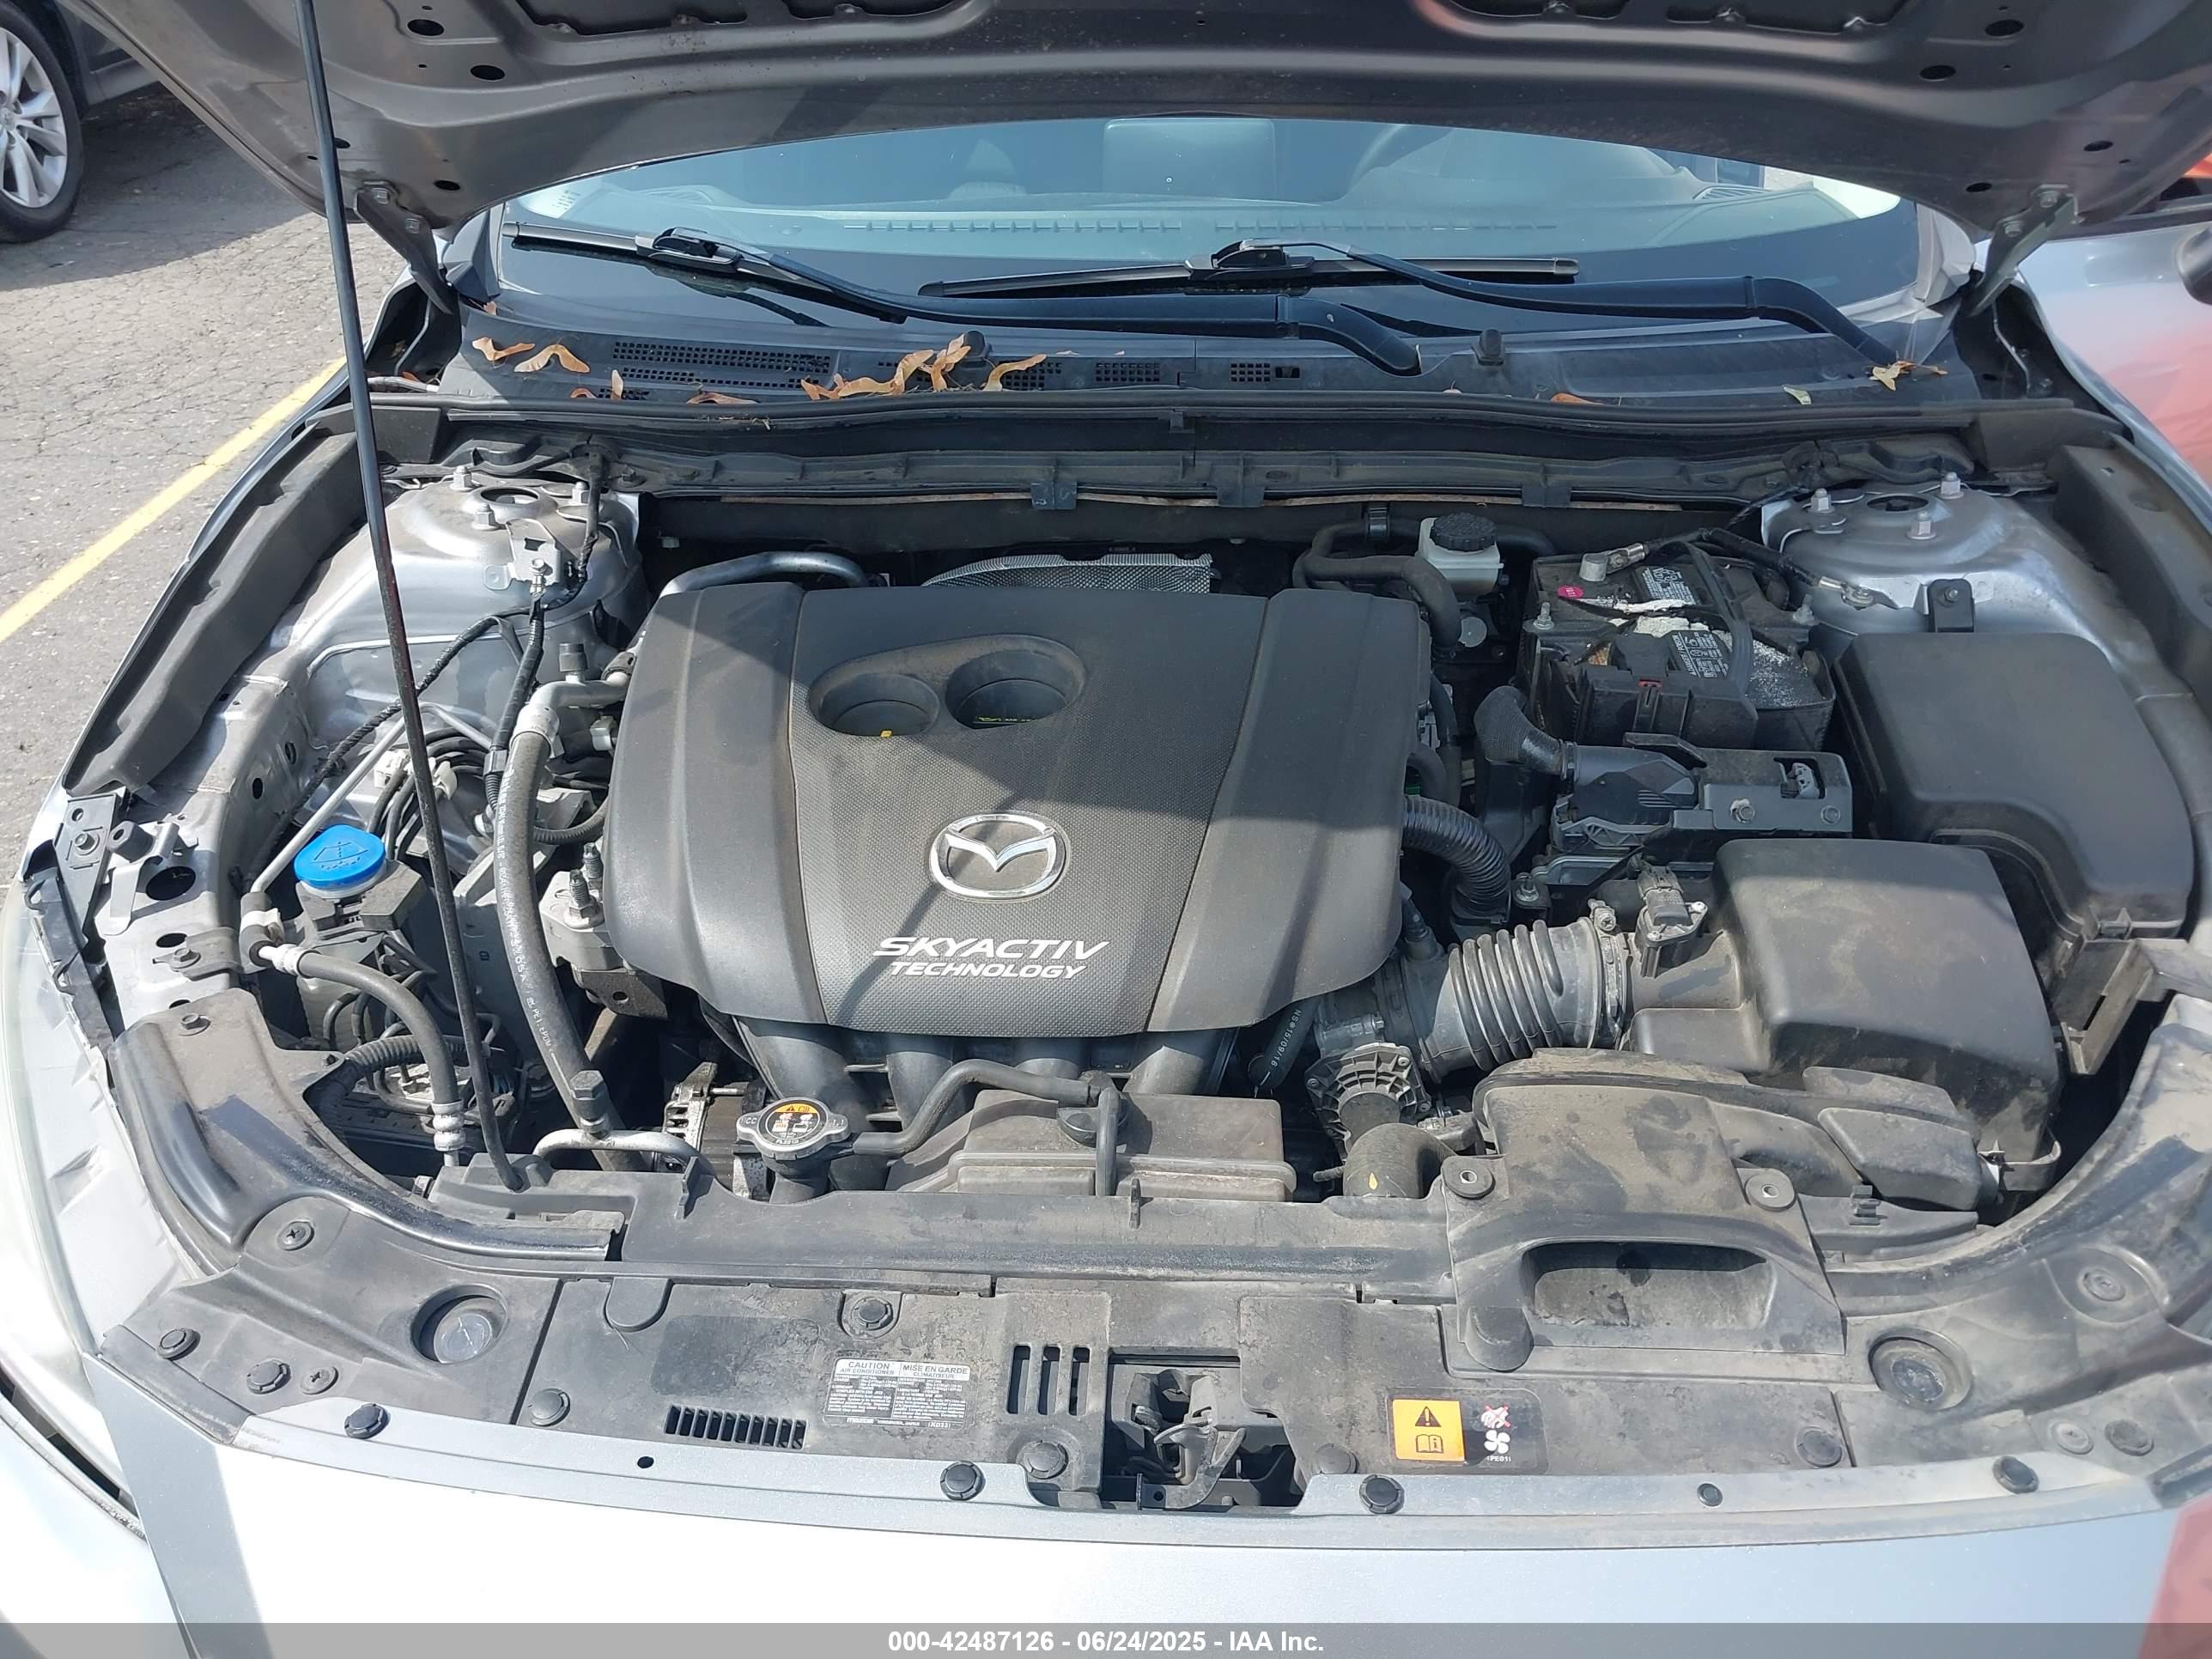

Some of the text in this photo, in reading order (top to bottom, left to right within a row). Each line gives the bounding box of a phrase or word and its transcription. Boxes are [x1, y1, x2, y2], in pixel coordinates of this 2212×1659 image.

[872, 937, 1109, 960] SKYACTIV
[890, 961, 1088, 980] TECHNOLOGY
[848, 1361, 890, 1370] CAUTION
[938, 1366, 969, 1375] GARDE
